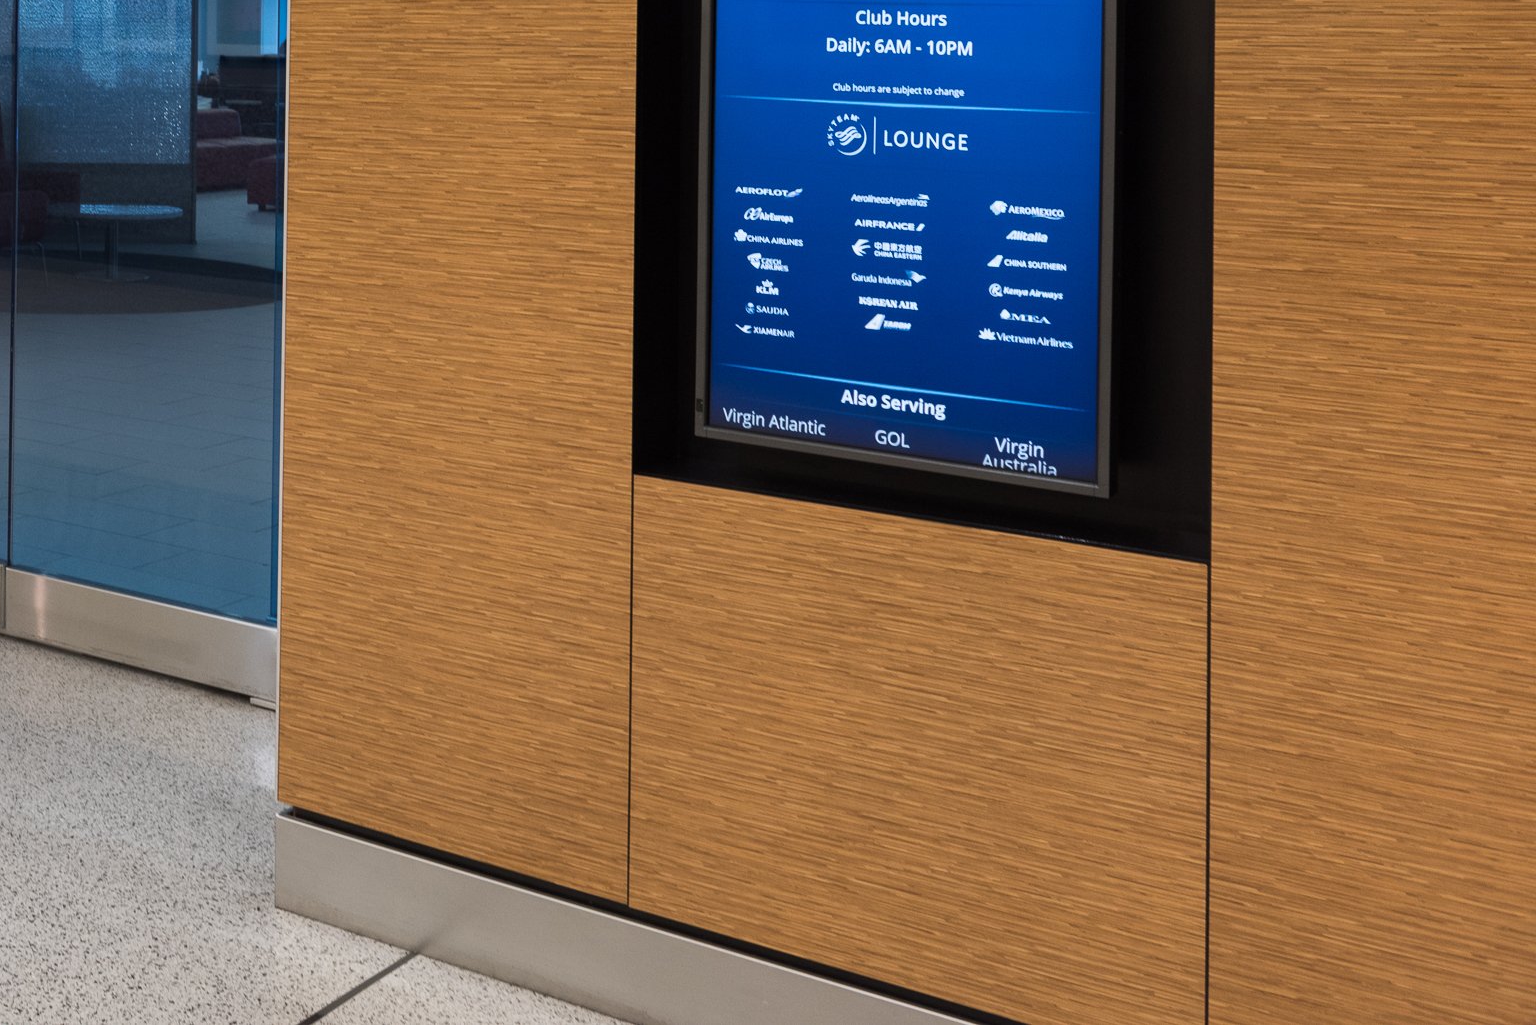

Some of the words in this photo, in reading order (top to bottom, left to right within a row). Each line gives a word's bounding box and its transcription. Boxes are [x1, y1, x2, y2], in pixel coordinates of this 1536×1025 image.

[856, 10, 891, 26] Club
[897, 11, 947, 26] Hours
[826, 37, 870, 55] Daily:
[875, 39, 911, 54] 6AM
[927, 41, 973, 56] 10PM
[833, 82, 850, 92] Club
[853, 83, 875, 93] hours
[878, 86, 891, 94] are
[893, 84, 920, 96] subject
[923, 86, 932, 95] to
[934, 86, 964, 98] change
[828, 113, 860, 146] SKYTEAM
[883, 130, 968, 151] LOUNGE
[735, 186, 788, 196] AEROFLOT
[747, 235, 770, 243] CHINA
[771, 237, 804, 247] AIRLINES
[1006, 230, 1048, 243] Alitalia
[874, 250, 893, 258] CHINA
[894, 252, 922, 261] EASTERN
[1004, 259, 1026, 268] CHINA
[1028, 261, 1067, 271] SOUTHERN
[851, 273, 877, 283] Garuda
[878, 276, 912, 286] Indonesia
[756, 286, 779, 295] KLM
[1003, 286, 1028, 297] Kenya
[1029, 289, 1064, 300] Airways
[859, 296, 898, 308] KOREAN
[899, 301, 918, 310] AIR
[756, 305, 789, 316] SAUDIA
[1012, 313, 1051, 324] MEA
[841, 389, 876, 407] Also
[881, 395, 946, 420] Serving
[723, 408, 765, 429] Virgin
[769, 415, 826, 436] Atlantic
[875, 430, 909, 449] GOL
[995, 437, 1044, 460] Virgin
